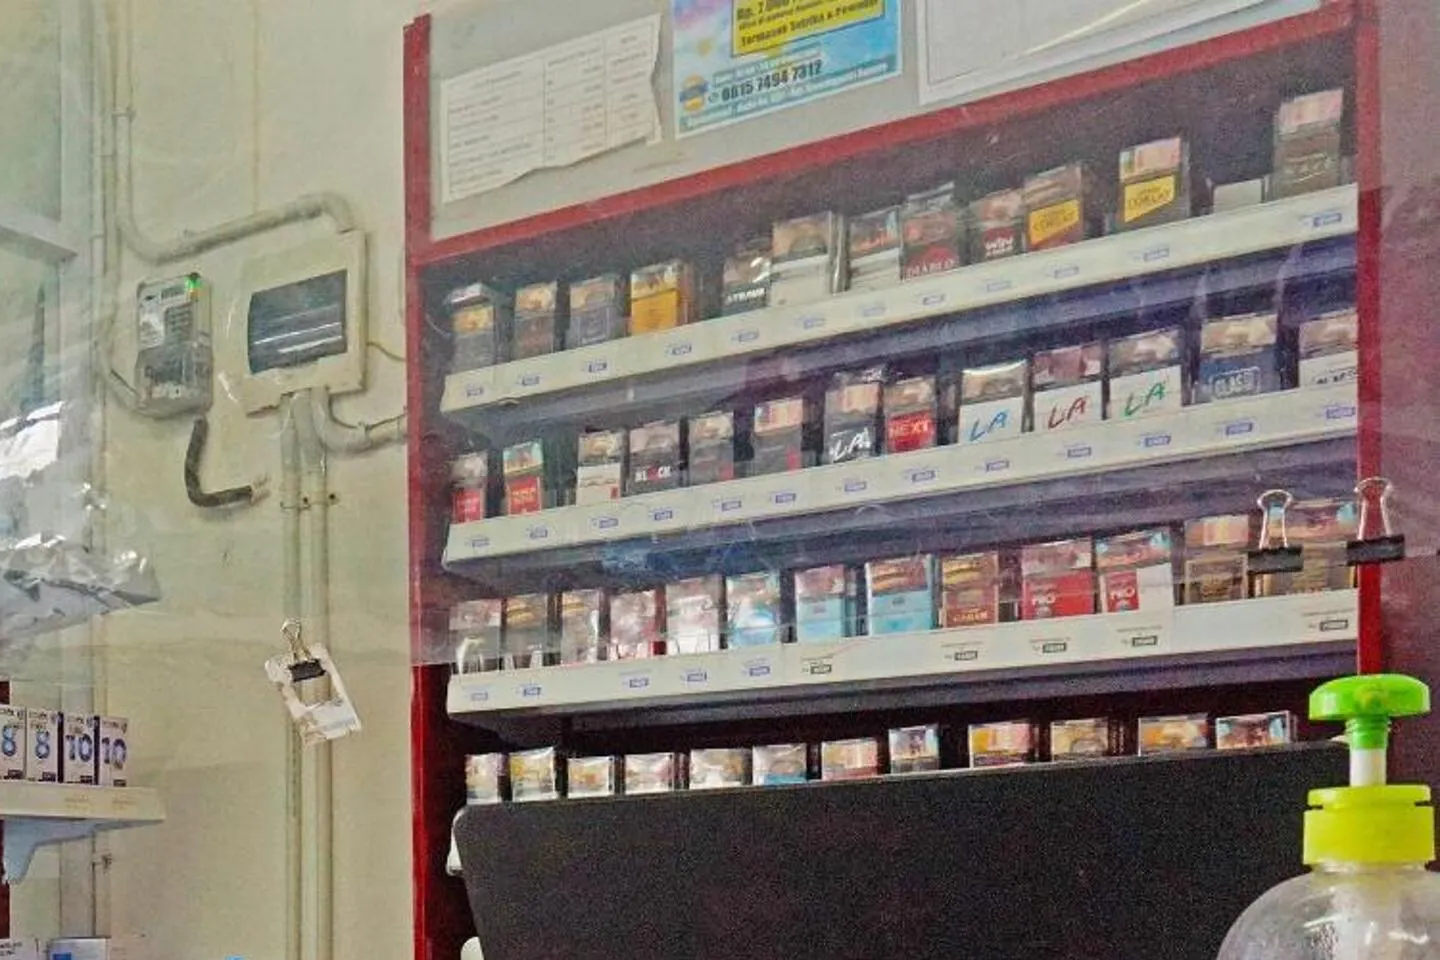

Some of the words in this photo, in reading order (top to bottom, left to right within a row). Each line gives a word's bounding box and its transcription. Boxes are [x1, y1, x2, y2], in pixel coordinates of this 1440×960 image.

[1048, 397, 1088, 429] LA
[1124, 382, 1166, 417] LA
[970, 410, 1008, 441] LA
